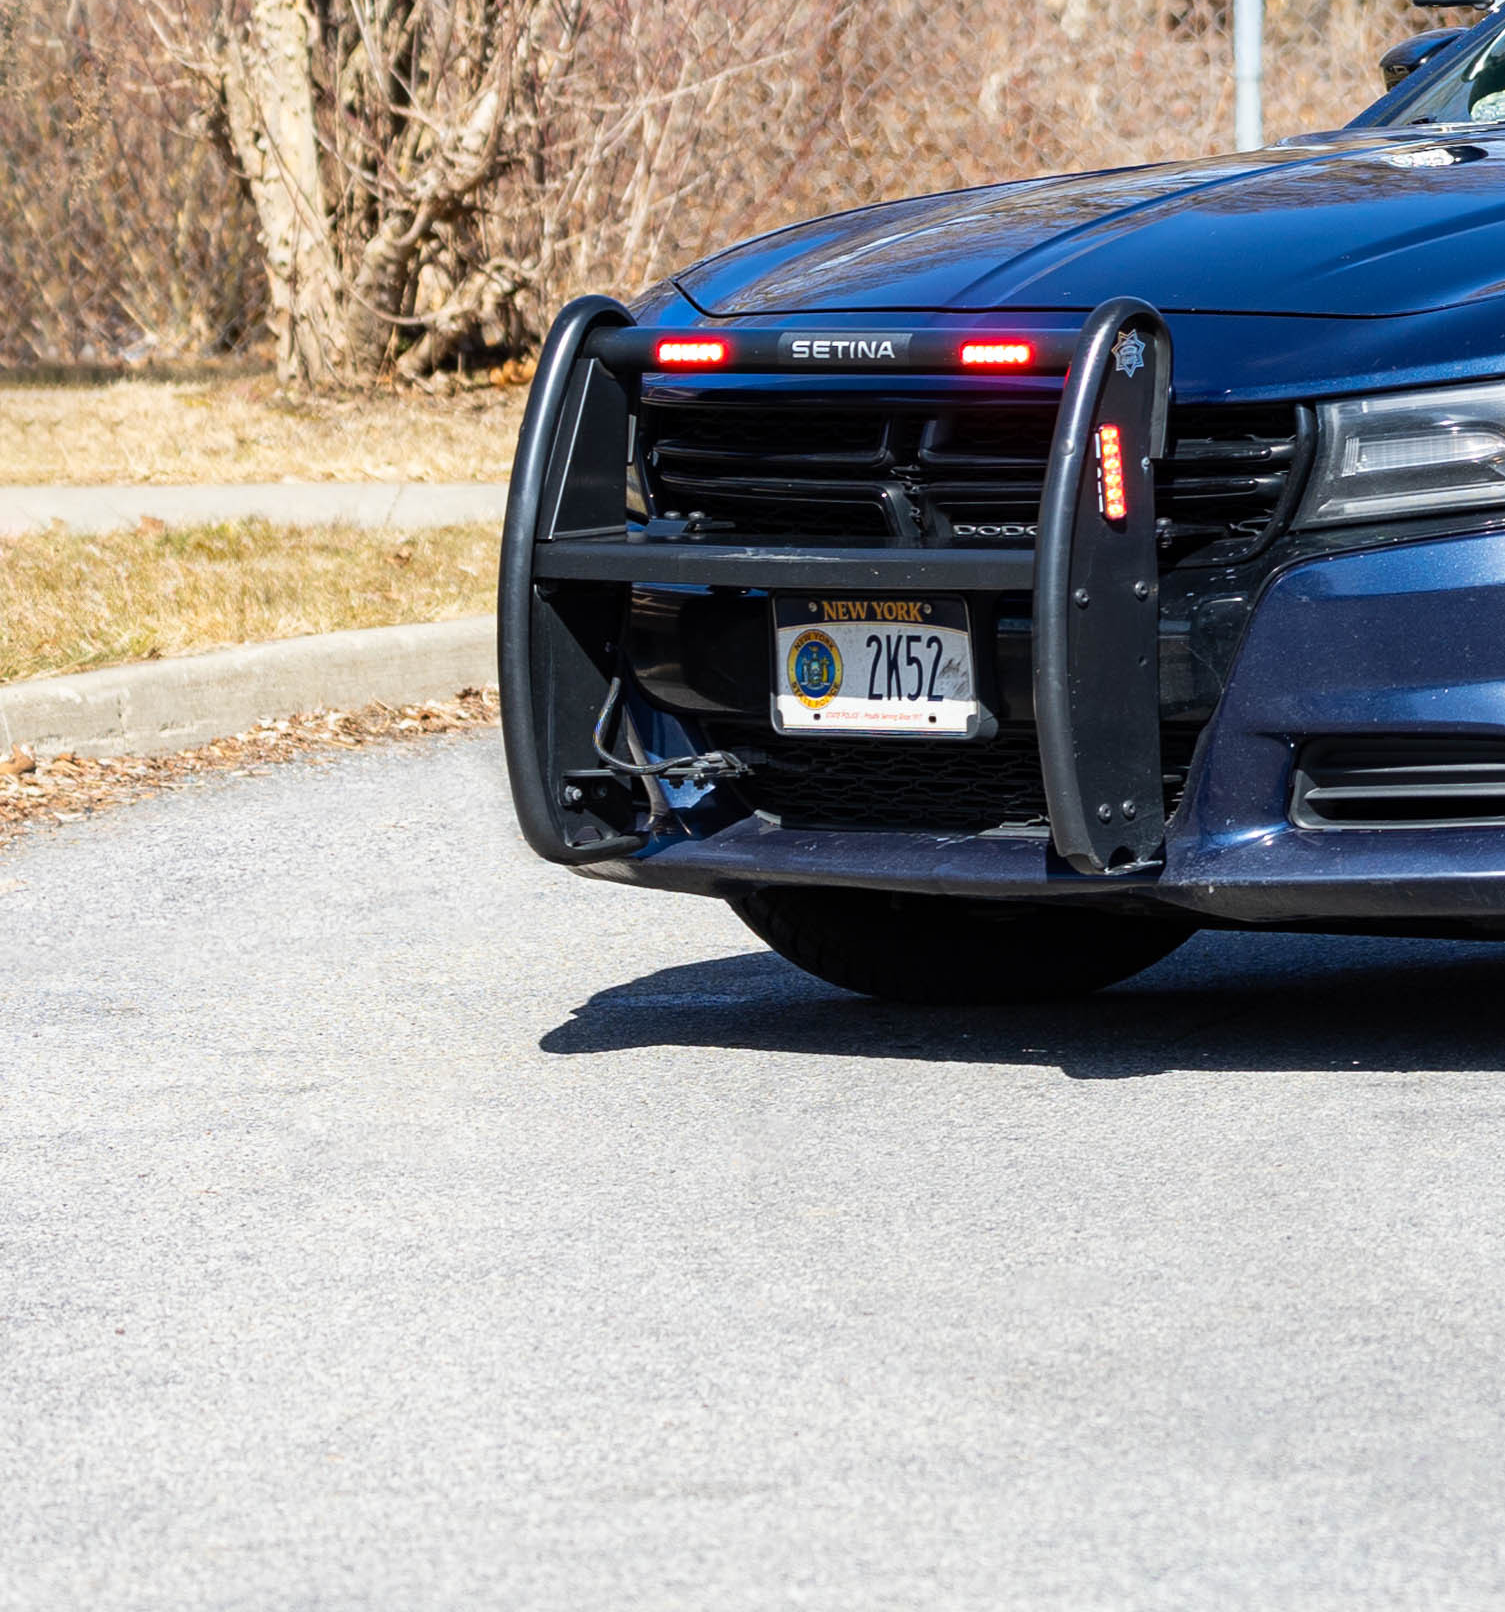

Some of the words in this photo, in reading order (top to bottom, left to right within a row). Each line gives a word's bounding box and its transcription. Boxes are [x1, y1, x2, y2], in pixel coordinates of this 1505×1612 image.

[791, 340, 896, 359] SETINA
[953, 524, 1039, 536] DOD
[822, 600, 868, 621] NEW
[871, 600, 923, 622] YORK
[866, 634, 944, 702] 2K52
